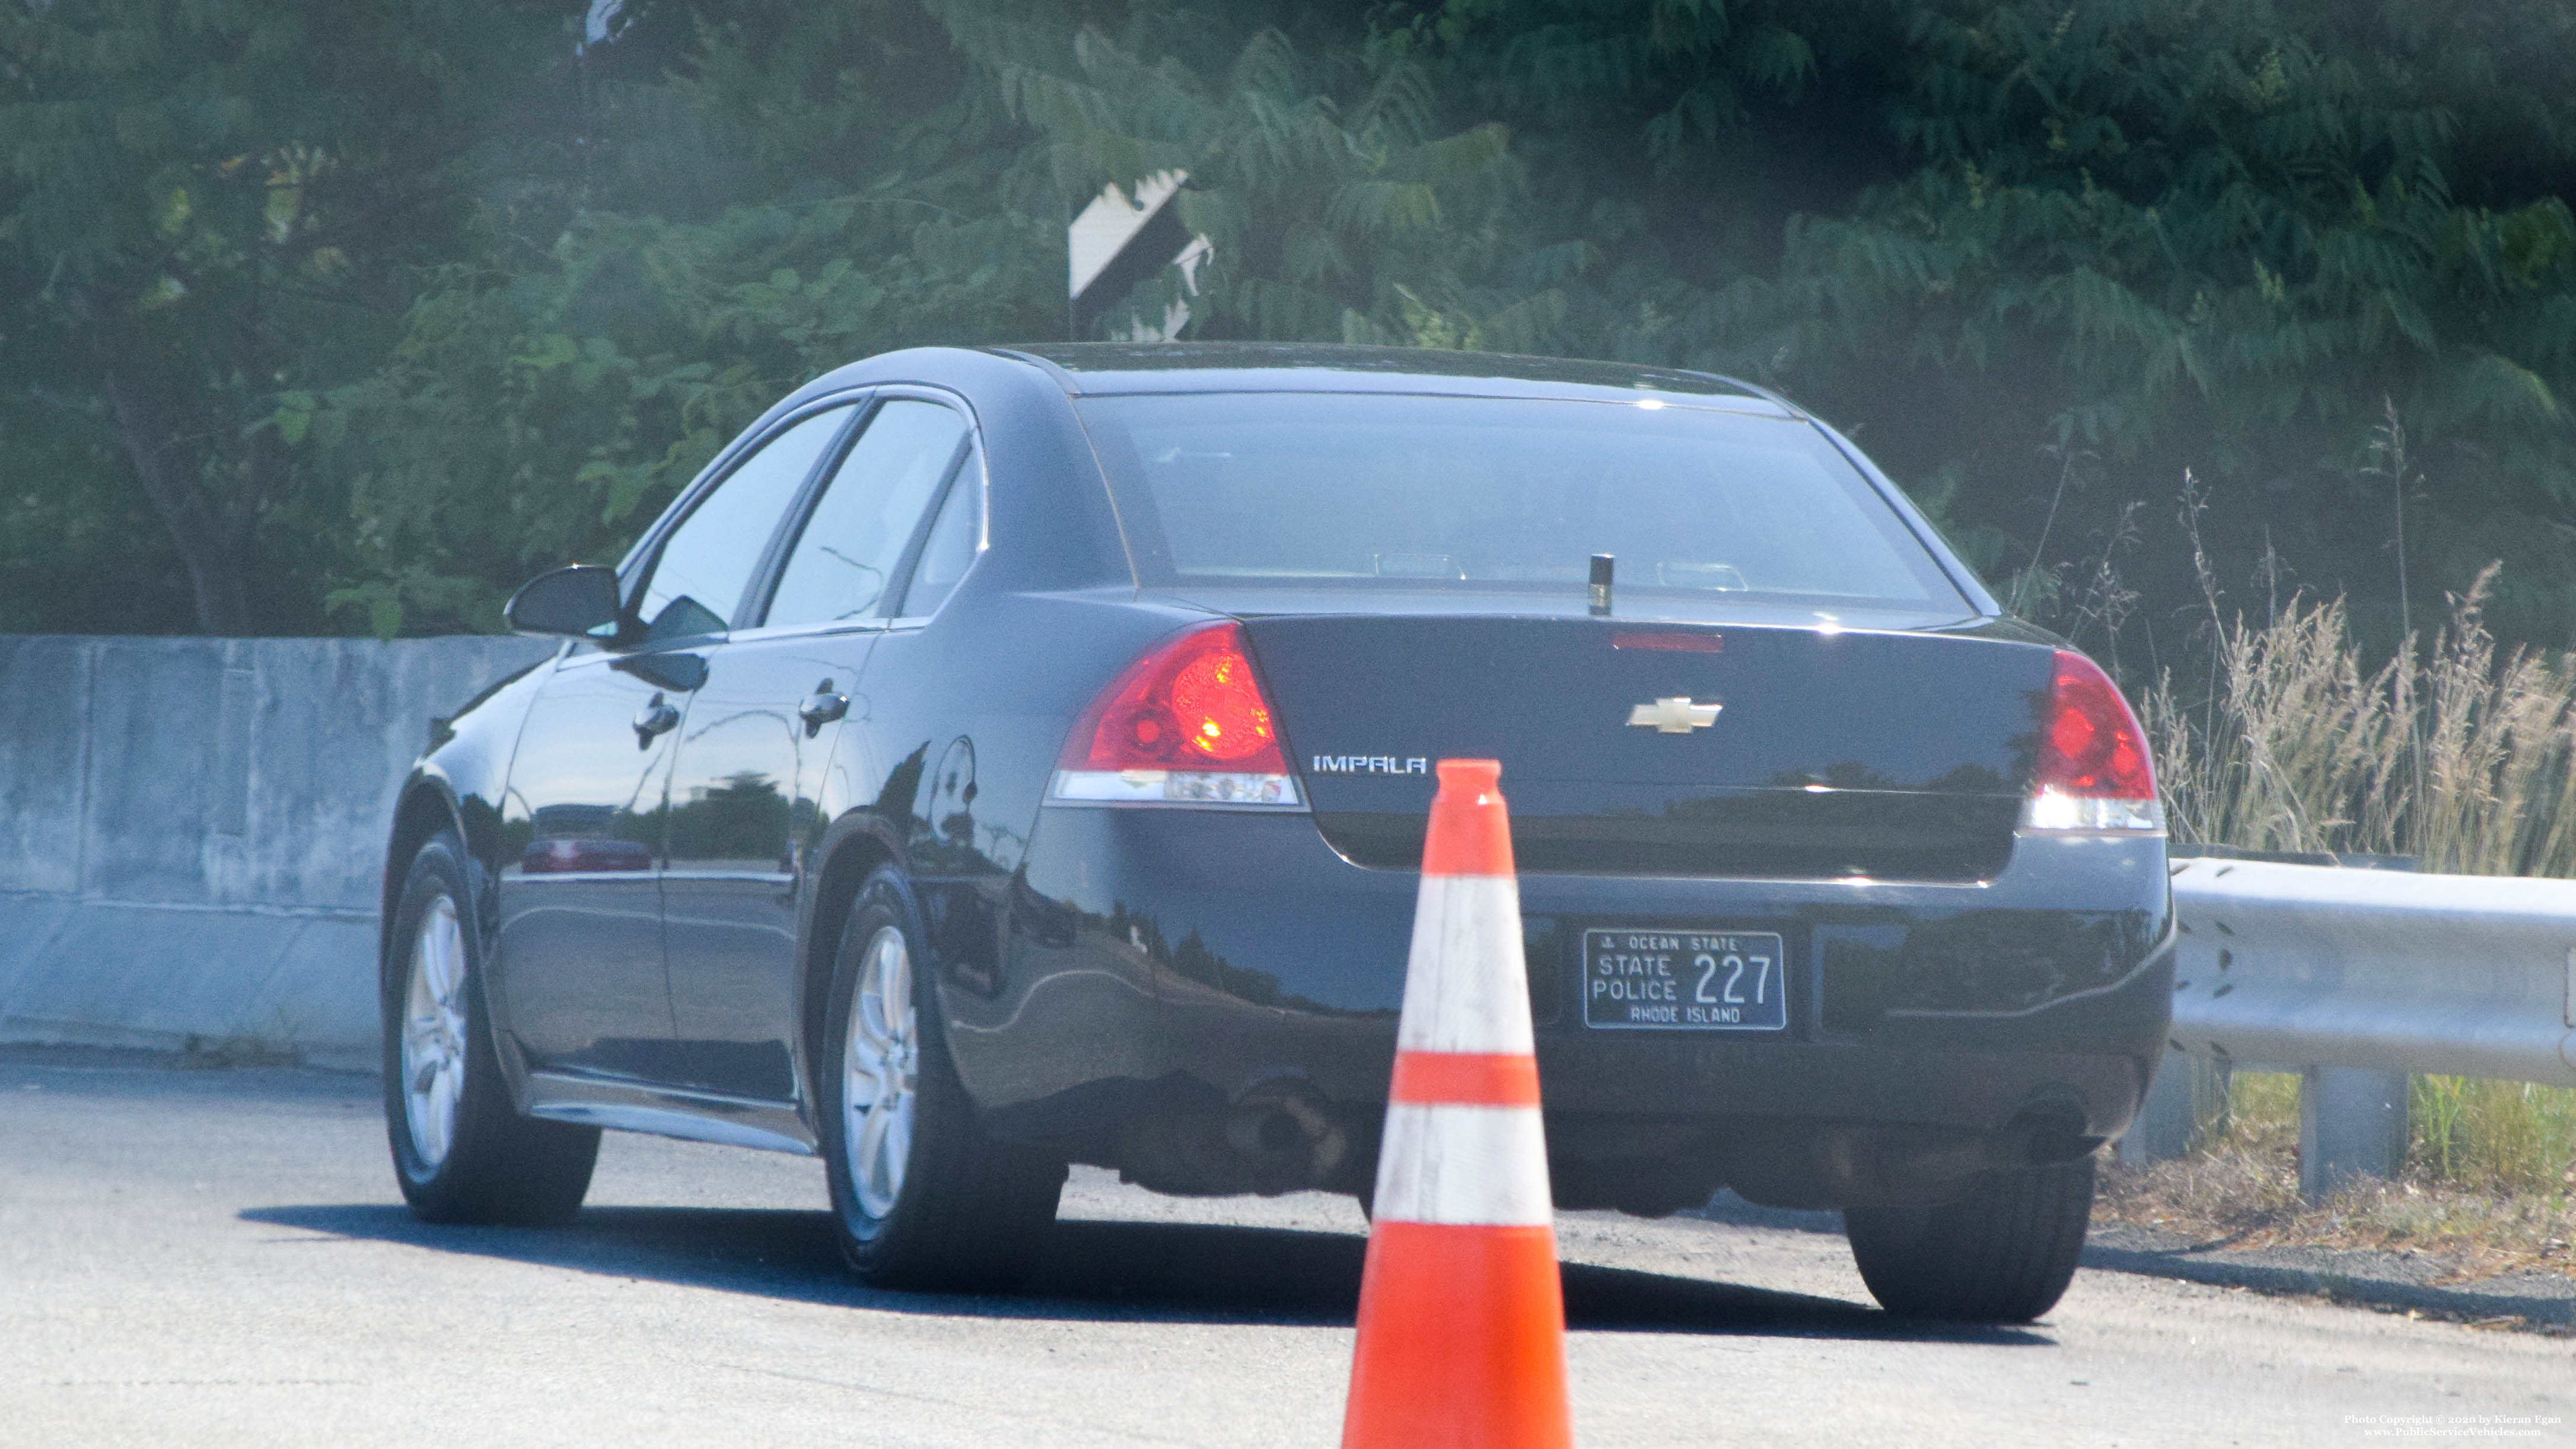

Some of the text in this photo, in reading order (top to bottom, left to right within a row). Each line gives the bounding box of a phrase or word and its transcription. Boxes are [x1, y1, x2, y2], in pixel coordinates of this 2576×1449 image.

[1313, 756, 1426, 774] IMPALA
[1629, 937, 1737, 951] OCEAN STATE
[1600, 954, 1671, 976] STATE
[1695, 954, 1771, 1004] 227
[1593, 980, 1677, 1001] POLICE
[1631, 1007, 1740, 1023] RHODE ISLAND
